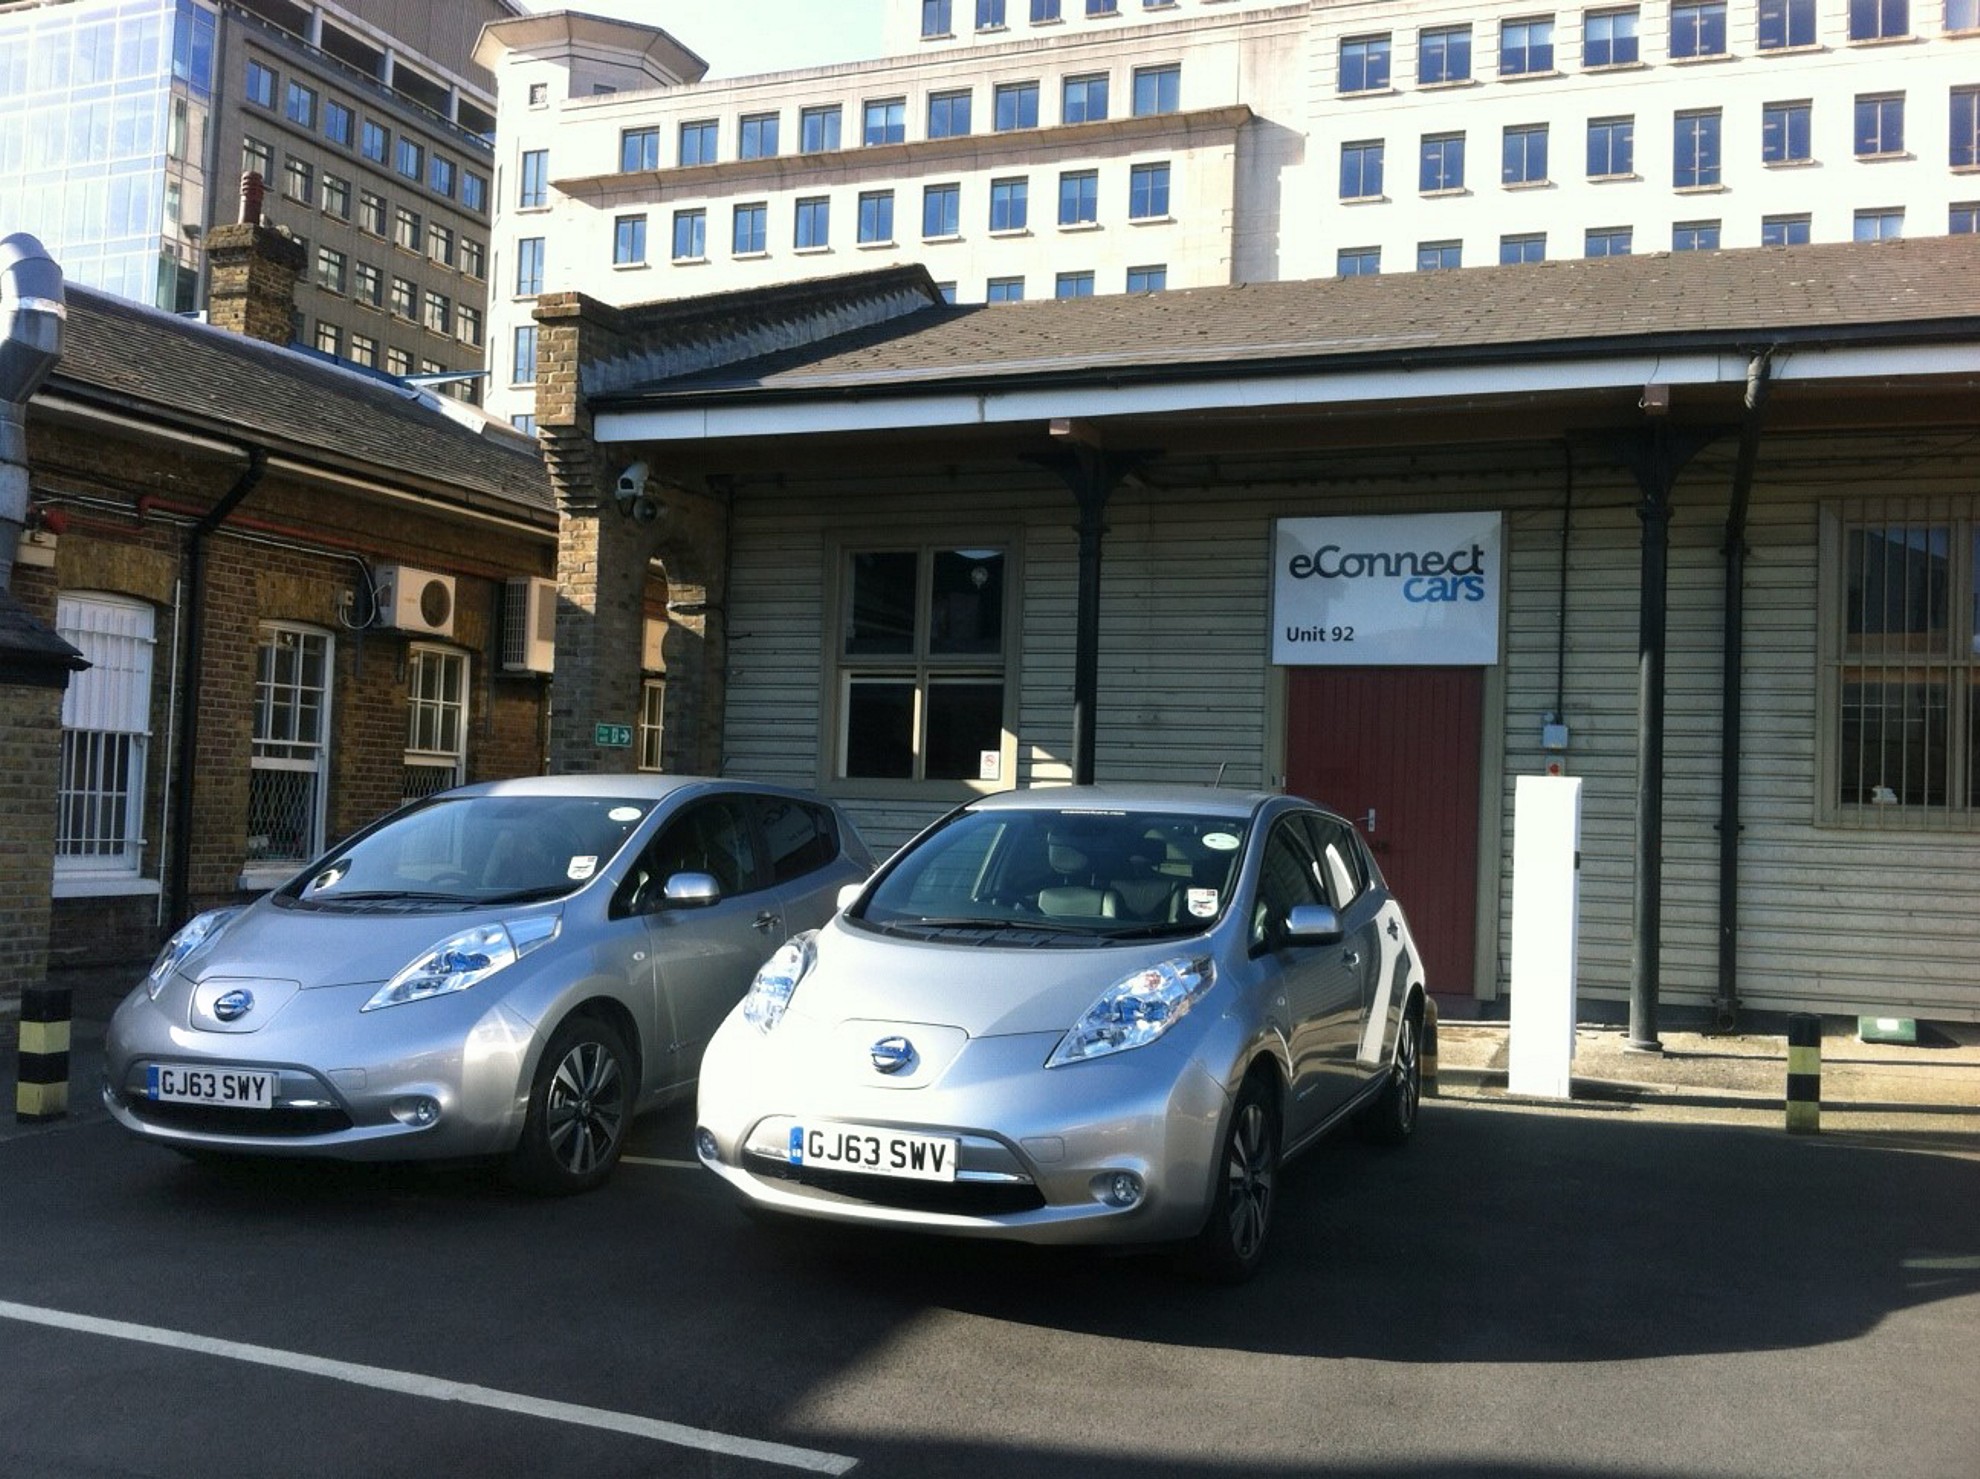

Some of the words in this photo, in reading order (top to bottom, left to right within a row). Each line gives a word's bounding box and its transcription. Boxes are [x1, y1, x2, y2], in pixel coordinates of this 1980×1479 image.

[1288, 544, 1485, 579] eConnect
[1403, 576, 1485, 602] cars
[1286, 625, 1326, 642] Unit
[1331, 626, 1354, 642] 92
[161, 1069, 217, 1098] GJ63
[222, 1074, 266, 1101] SWY
[808, 1129, 881, 1166] GJ63
[889, 1139, 947, 1173] SWV
